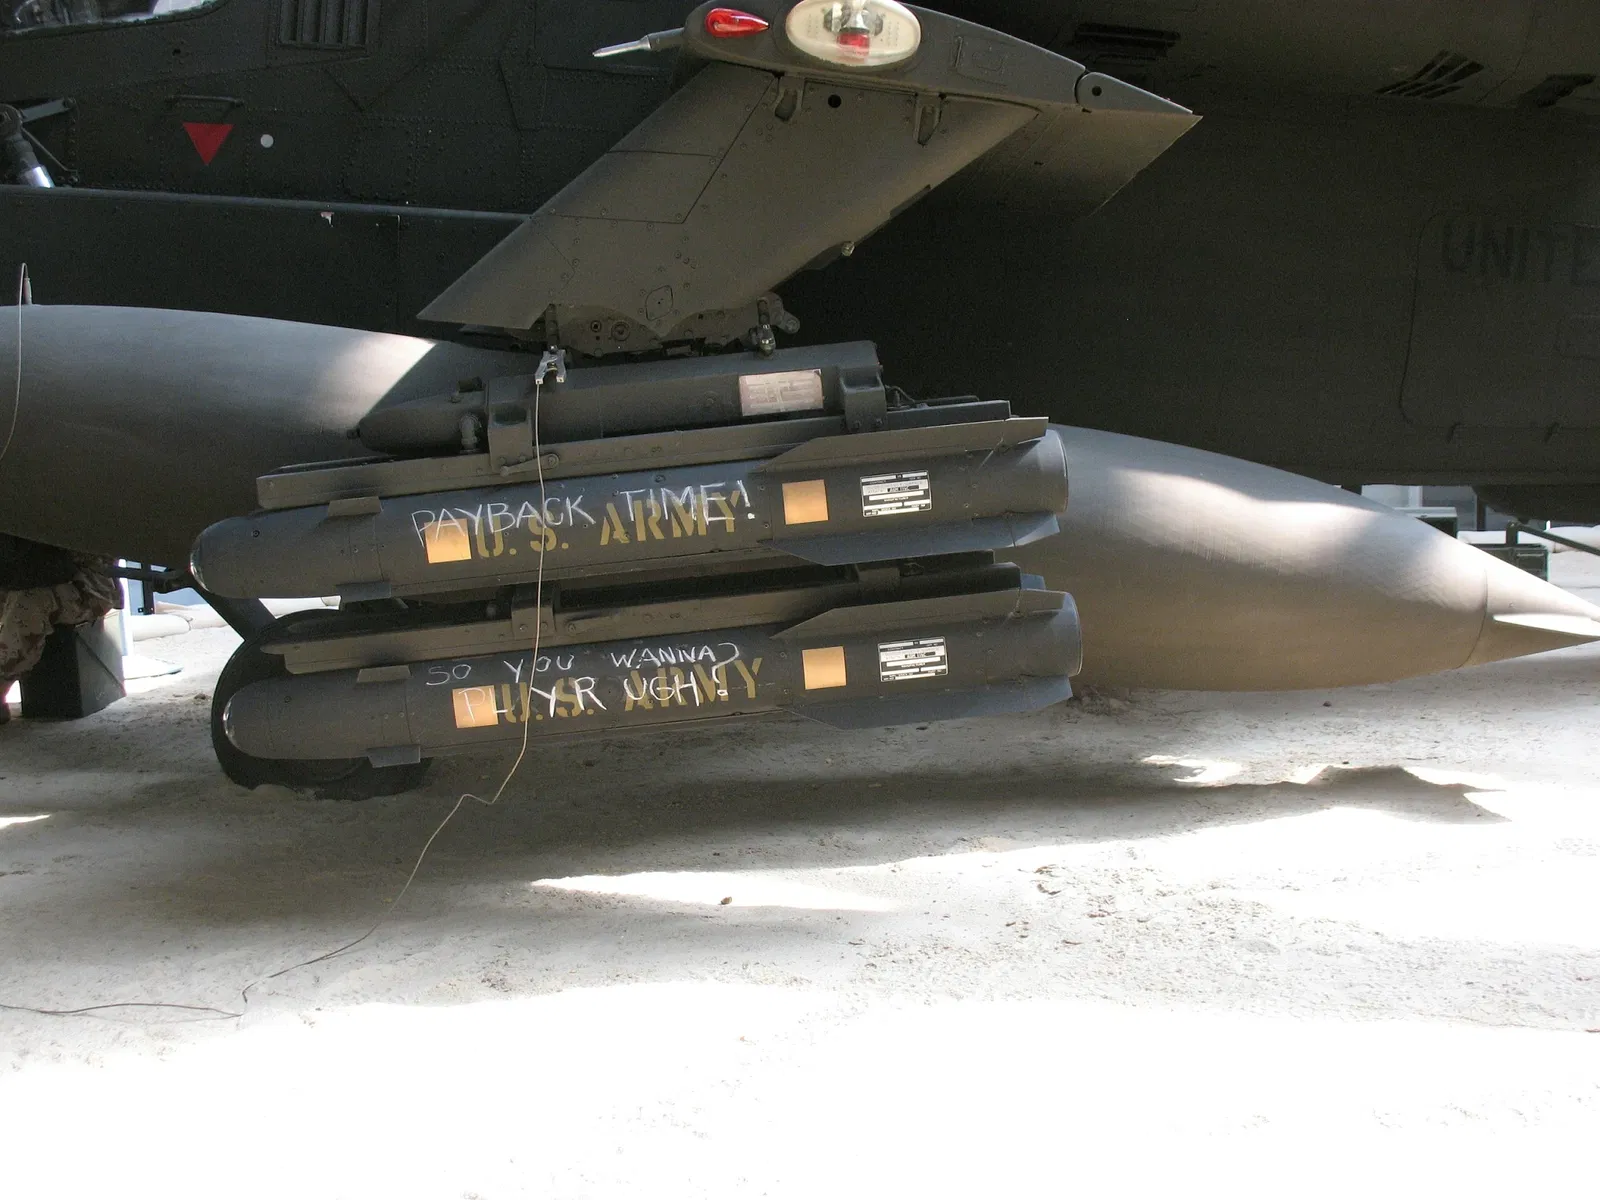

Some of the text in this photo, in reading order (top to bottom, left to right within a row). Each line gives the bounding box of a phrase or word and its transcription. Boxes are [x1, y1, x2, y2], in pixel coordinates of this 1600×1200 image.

[411, 480, 756, 548] PAYBACK TIME!
[600, 490, 741, 546] ARMY
[426, 645, 697, 686] SO YOU WANNA
[624, 657, 763, 712] ARMY
